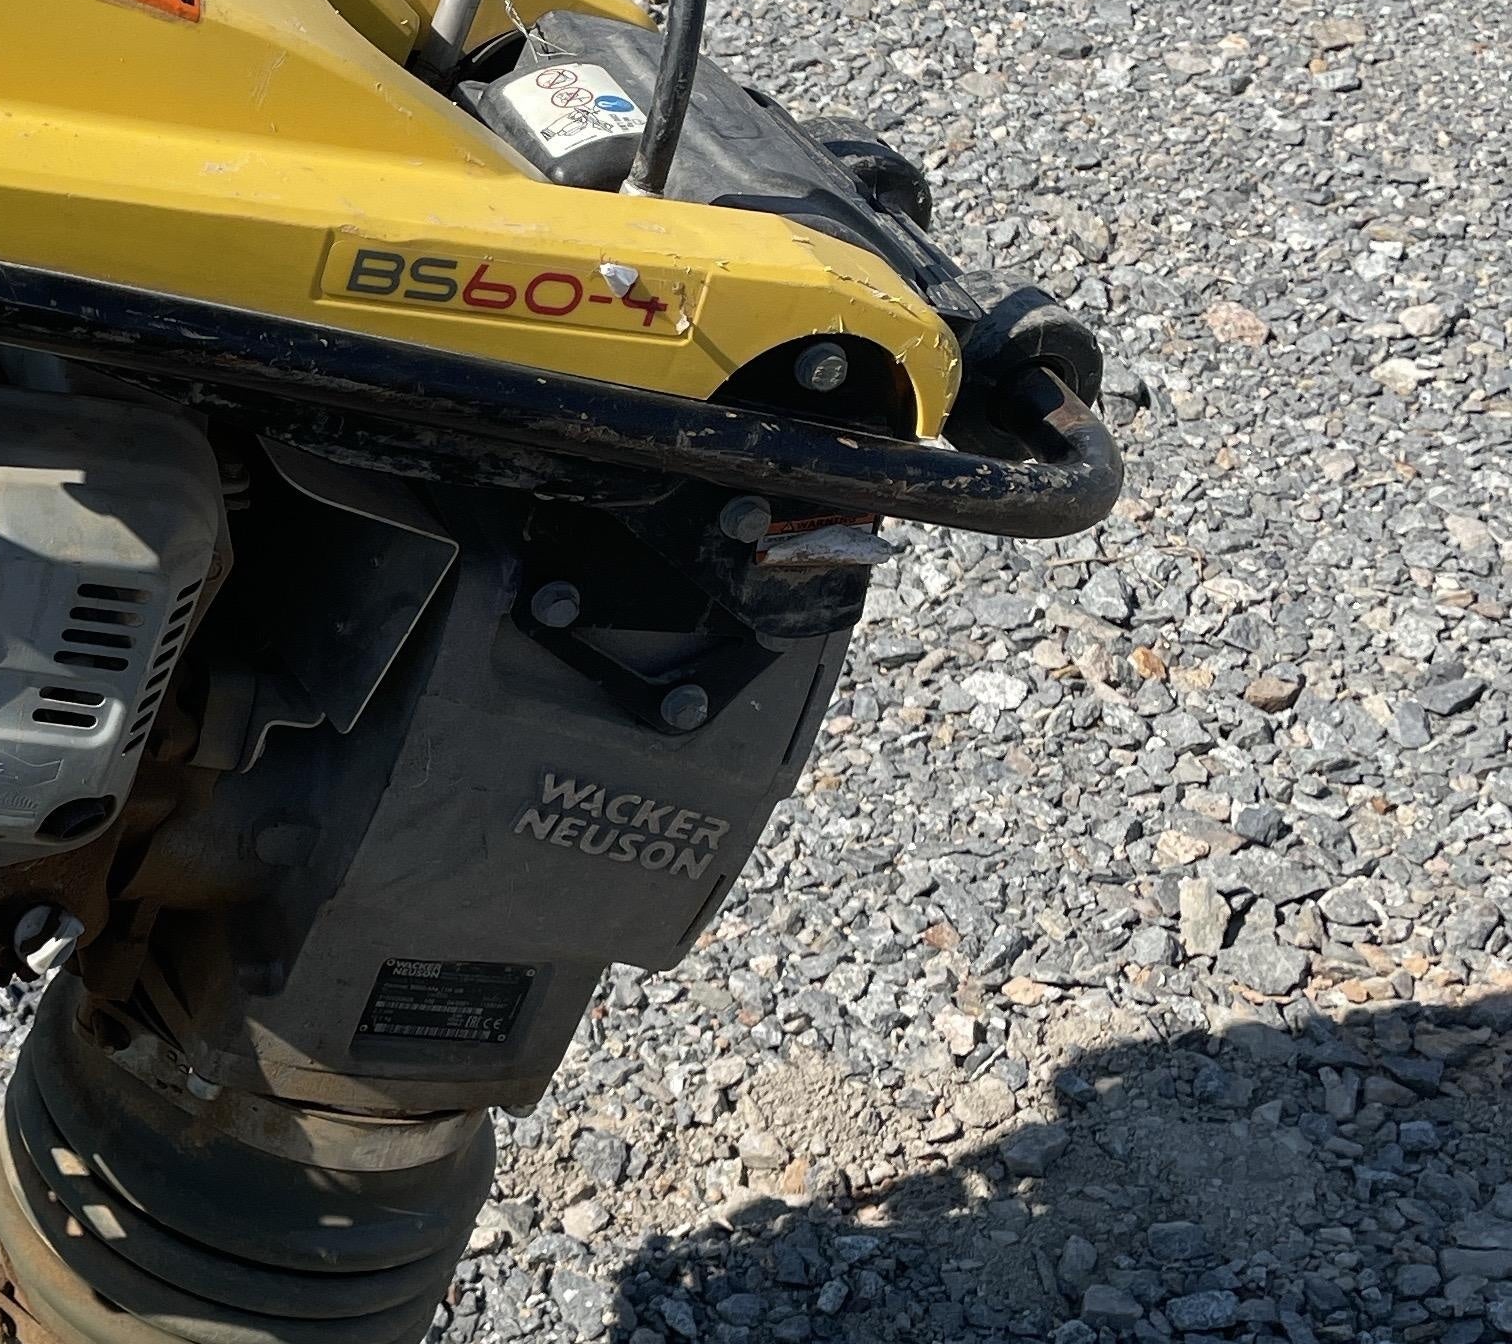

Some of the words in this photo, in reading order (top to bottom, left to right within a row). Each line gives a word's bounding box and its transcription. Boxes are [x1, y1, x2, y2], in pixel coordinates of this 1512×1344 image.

[346, 248, 669, 327] BS60-4
[513, 808, 714, 880] NEUSON
[541, 773, 730, 850] WACKER
[392, 967, 441, 979] NEUSON
[395, 960, 443, 971] WACKER
